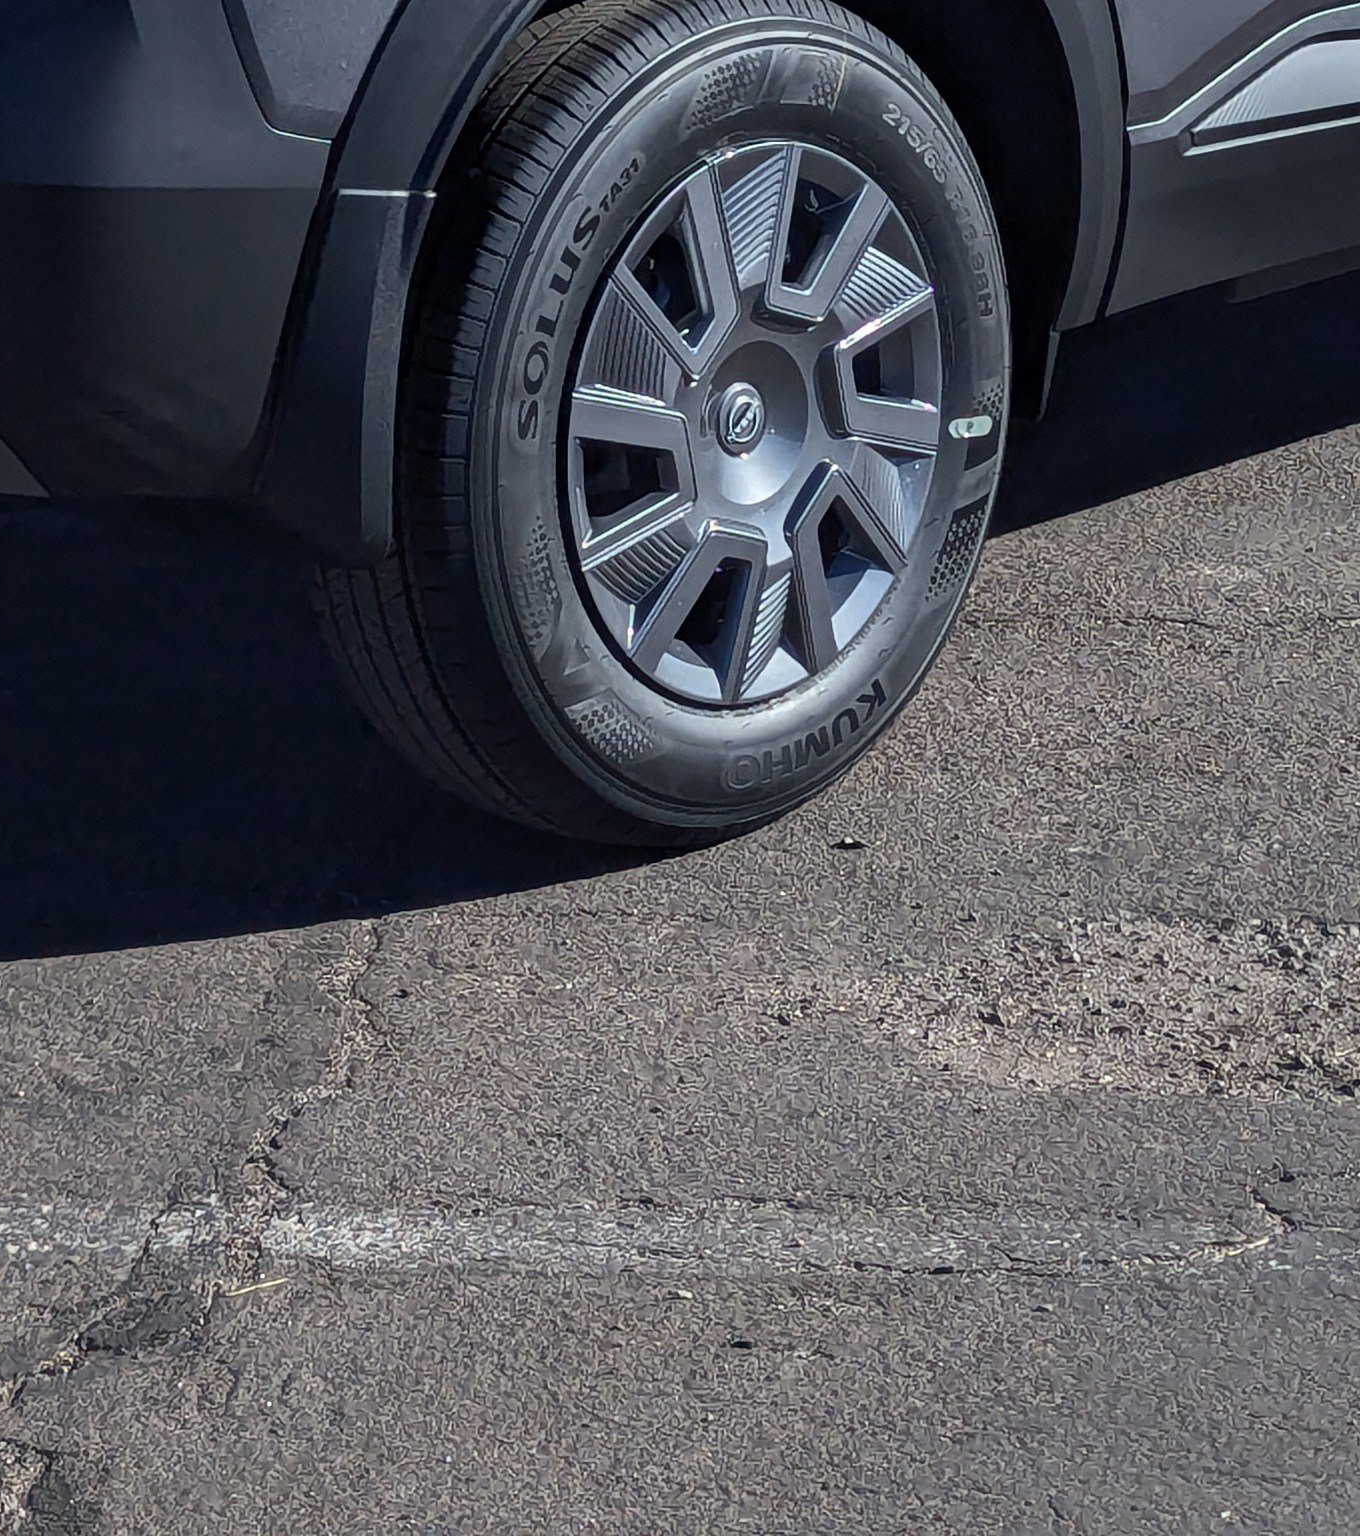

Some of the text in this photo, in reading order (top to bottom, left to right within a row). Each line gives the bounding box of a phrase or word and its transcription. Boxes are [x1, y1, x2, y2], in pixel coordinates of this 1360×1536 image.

[882, 102, 947, 184] 215/65
[517, 157, 640, 441] SOLUS TA31
[724, 678, 887, 791] KUMHO
